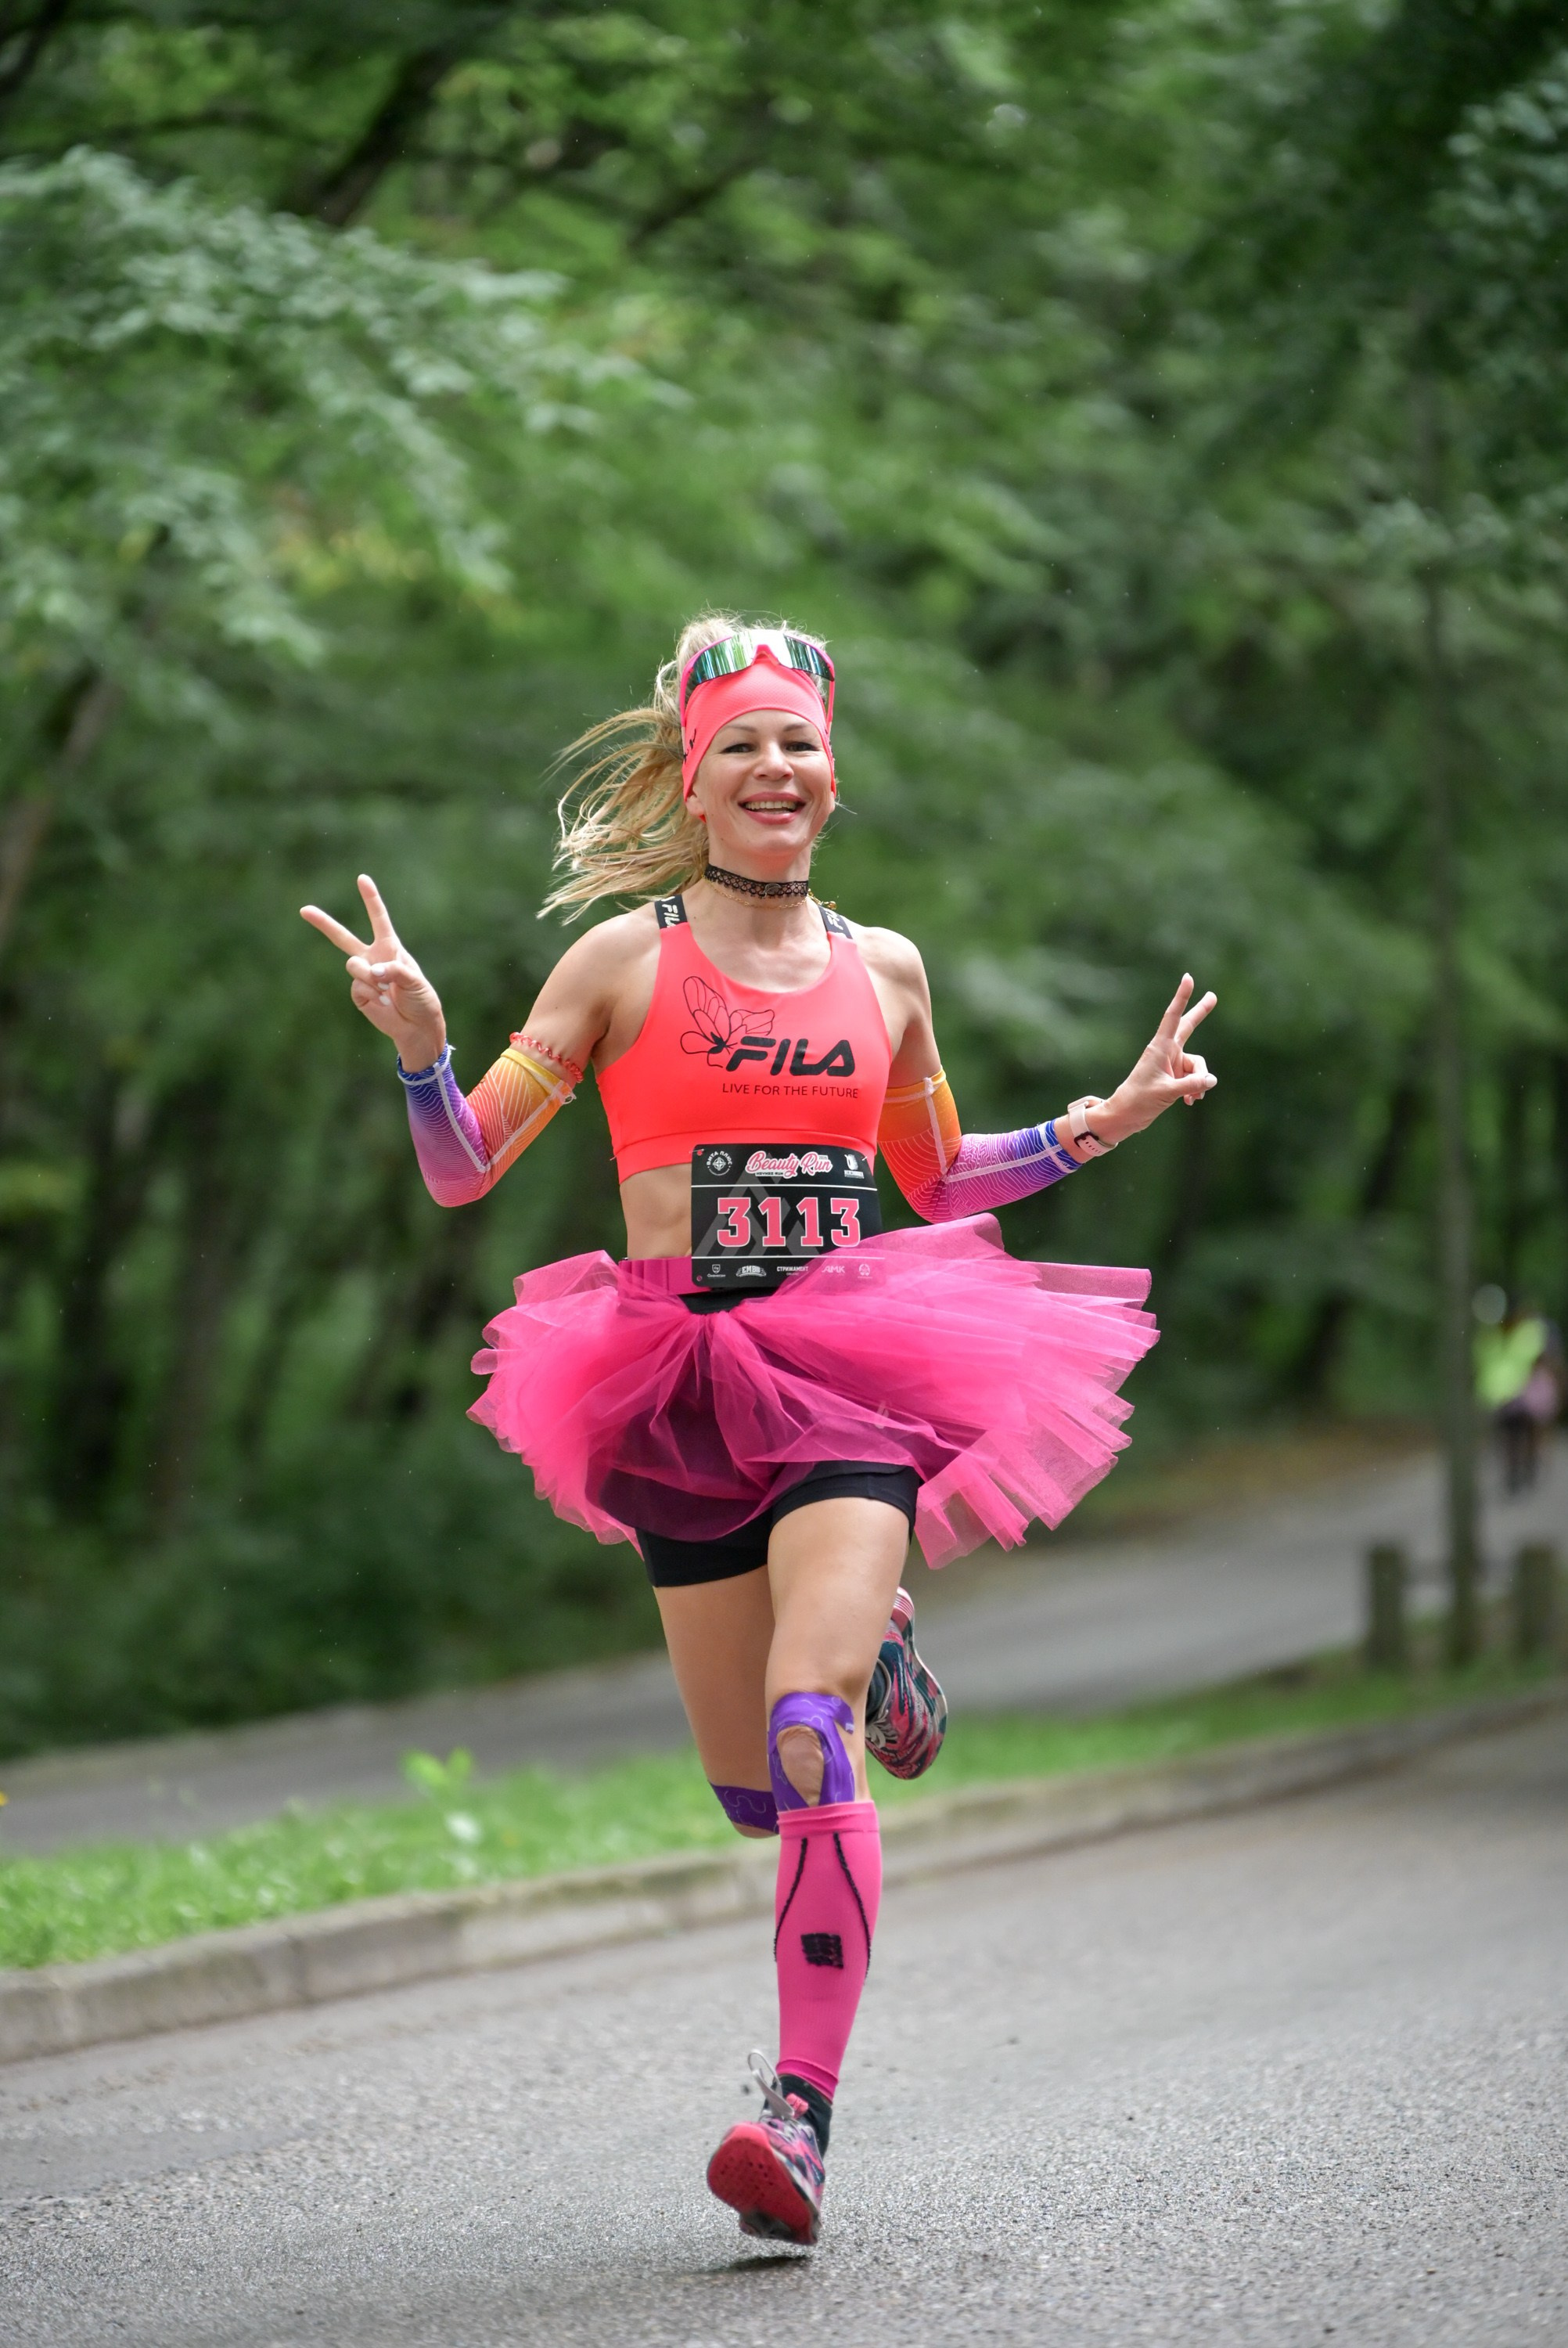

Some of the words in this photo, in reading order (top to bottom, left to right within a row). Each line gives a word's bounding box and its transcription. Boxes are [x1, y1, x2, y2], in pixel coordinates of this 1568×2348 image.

[662, 904, 680, 927] FIL
[726, 1035, 855, 1077] FILA
[722, 1082, 750, 1094] LIVE
[753, 1085, 780, 1095] FOR
[783, 1086, 807, 1096] THE
[812, 1086, 858, 1099] FUTURE
[746, 1151, 799, 1178] Beauty
[800, 1152, 833, 1176] Run
[717, 1197, 861, 1248] 3113
